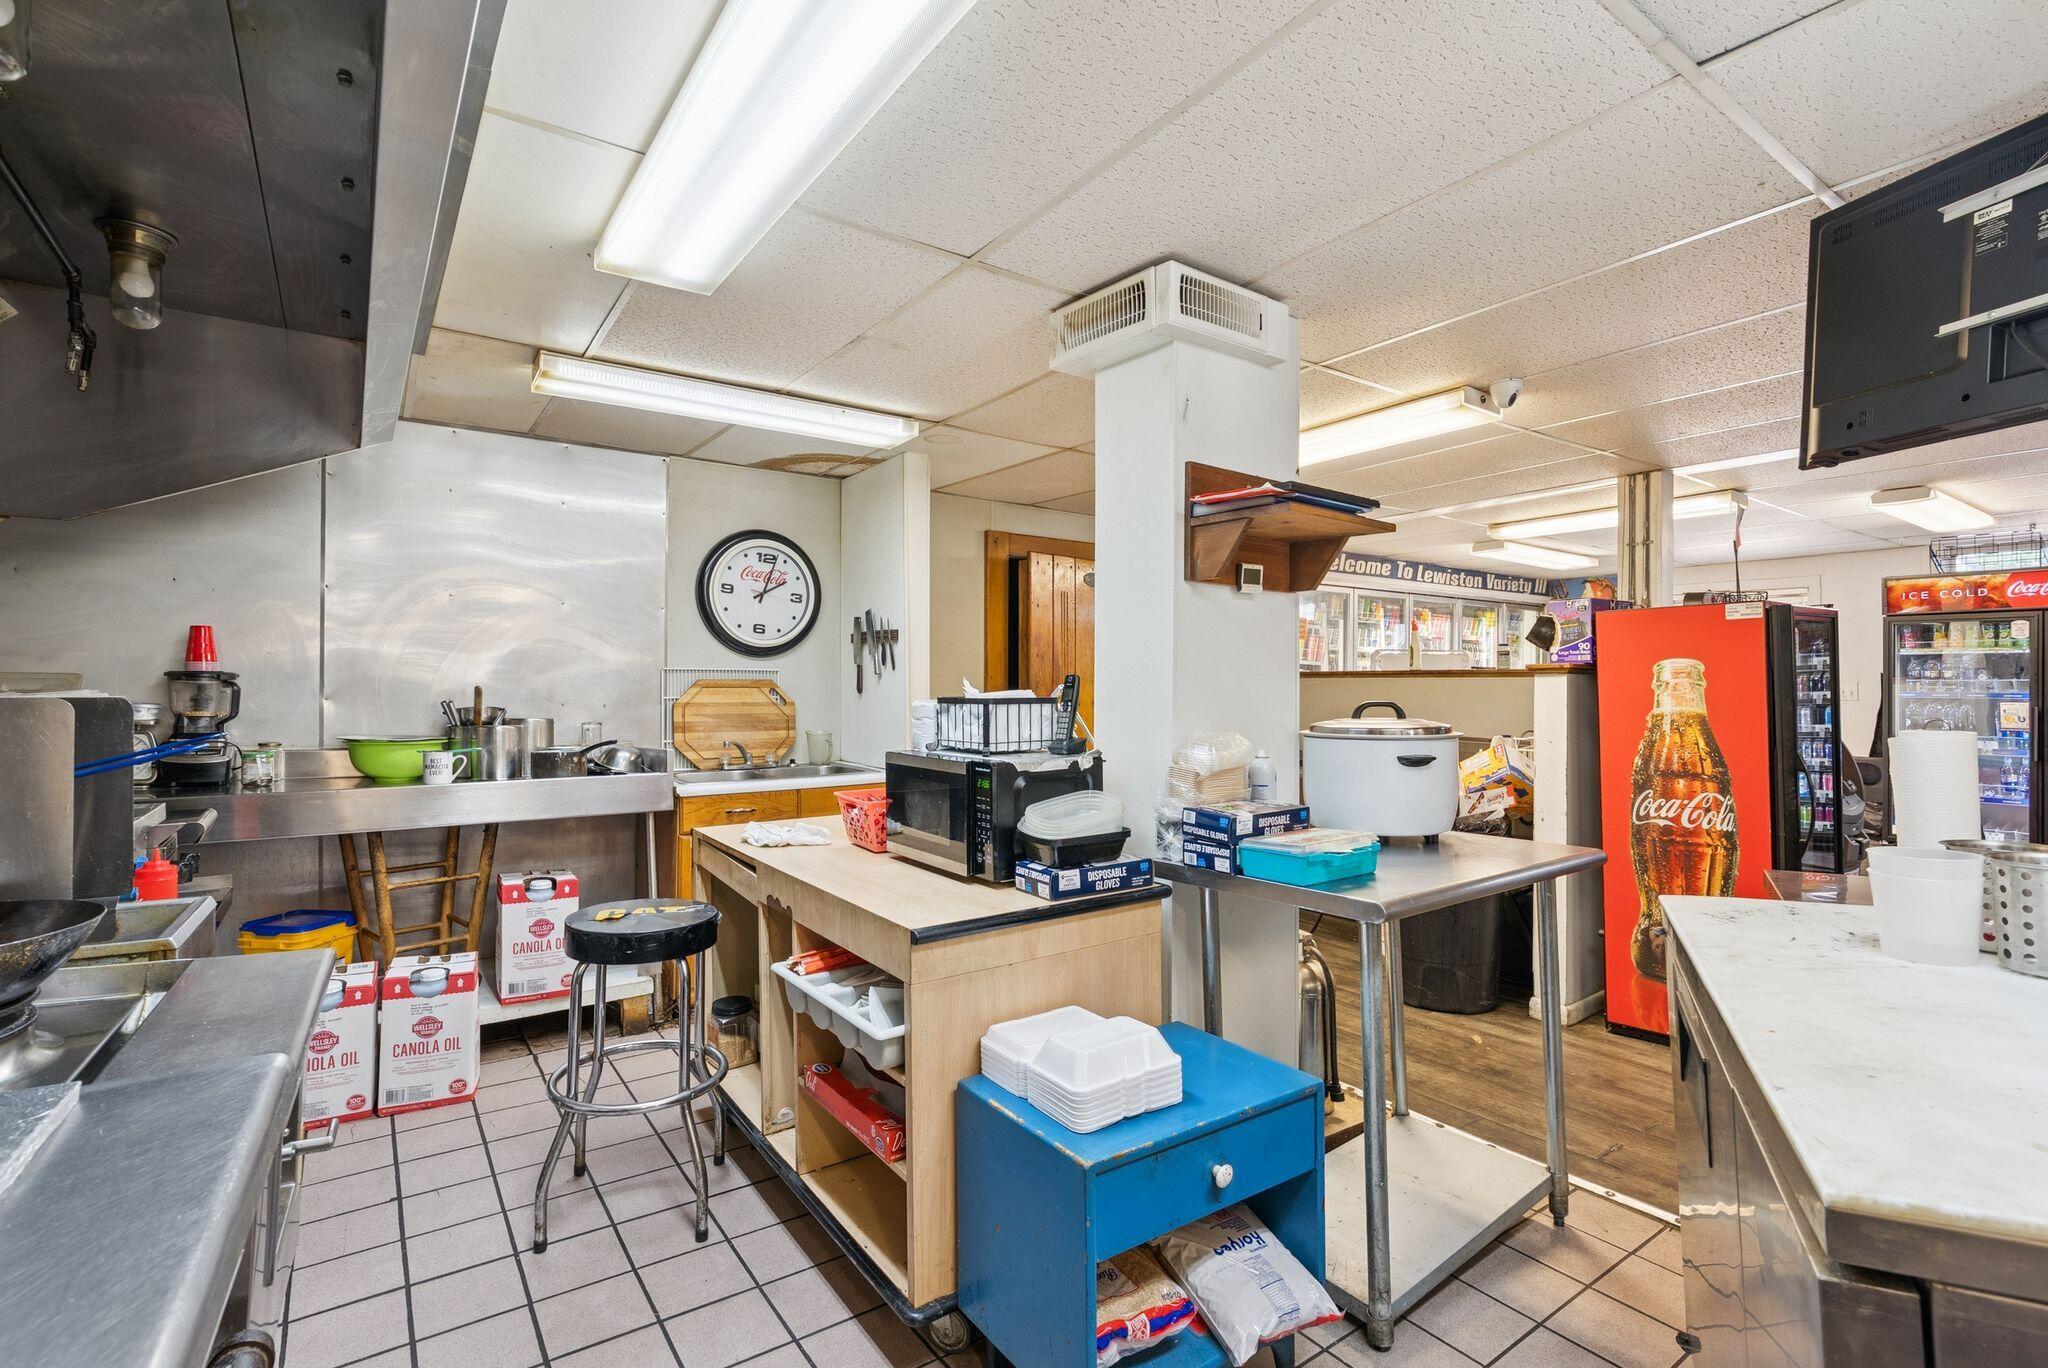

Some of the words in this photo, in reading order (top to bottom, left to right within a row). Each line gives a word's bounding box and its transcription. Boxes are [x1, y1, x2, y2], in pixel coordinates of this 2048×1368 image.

[756, 552, 778, 565] 12
[740, 565, 790, 586] Coca-Cola
[1330, 553, 1392, 576] elcome
[1397, 560, 1414, 580] To
[1416, 564, 1483, 588] Lewiston
[1486, 573, 1532, 595] Variety
[721, 582, 735, 594] 9
[1901, 591, 1930, 600] ICE
[1939, 588, 1989, 599] COLD
[790, 592, 803, 604] 3
[752, 623, 766, 635] 6
[1577, 642, 1591, 651] 90
[1632, 789, 1735, 832] Coca-Cola
[1258, 814, 1291, 828] DISPOSABLE
[1183, 825, 1210, 837] DISPOSABLE
[1210, 831, 1229, 842] GLOVES
[1264, 825, 1285, 836] GLOVES
[1183, 842, 1202, 852] GLOVES
[1201, 844, 1231, 857] DISPOSABLE
[1087, 866, 1128, 882] DISPOSABLE
[1095, 878, 1121, 891] GLOVES
[512, 940, 552, 955] CANOLA
[555, 938, 565, 950] OI
[413, 1022, 442, 1032] WELLSLEY
[392, 1039, 440, 1058] CANOLA
[444, 1036, 462, 1051] OIL
[340, 1051, 361, 1067] OIL
